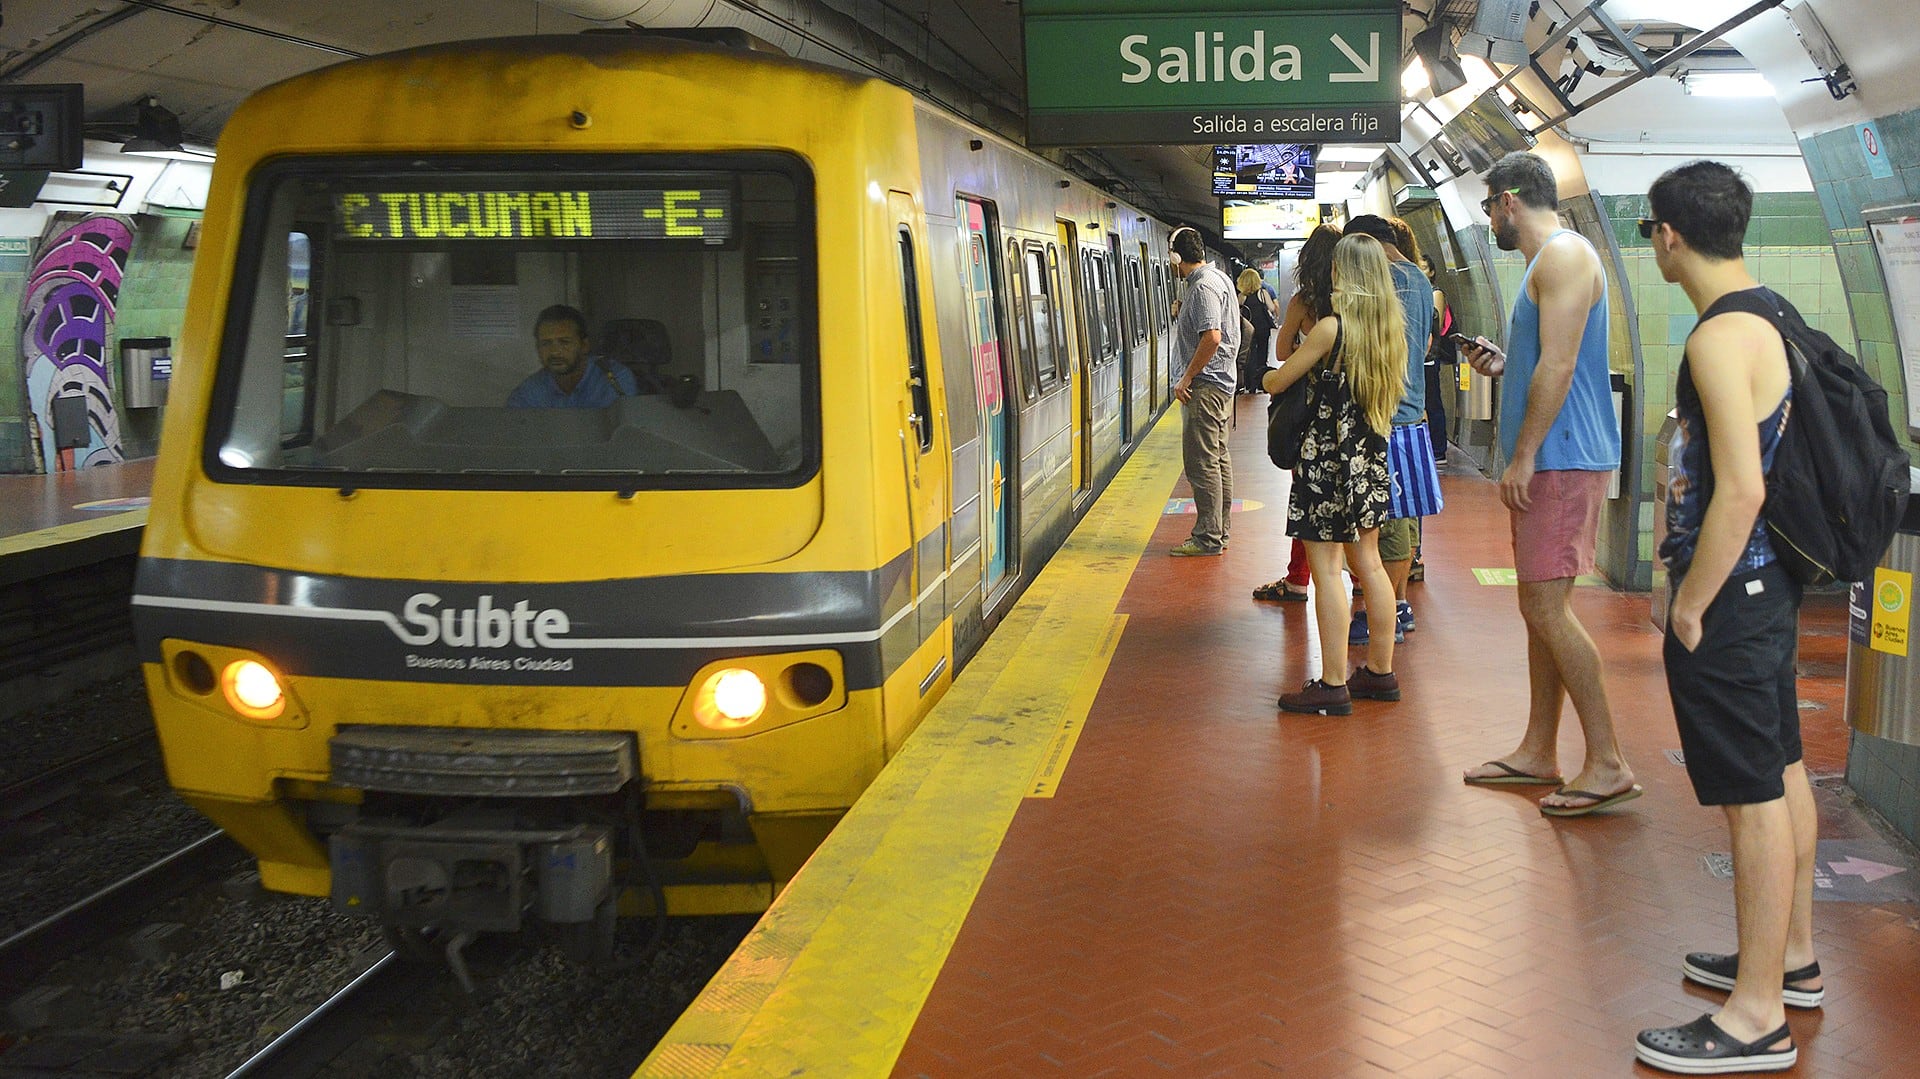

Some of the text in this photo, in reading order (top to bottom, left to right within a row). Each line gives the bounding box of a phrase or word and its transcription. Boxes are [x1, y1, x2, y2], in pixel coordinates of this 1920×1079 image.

[1119, 30, 1302, 84] Salida
[1192, 112, 1378, 135] Salida a escalera fija
[343, 191, 593, 238] C.TUCUMAN
[403, 592, 570, 648] Subte
[405, 654, 574, 671] Buenos Aires Ciudad
